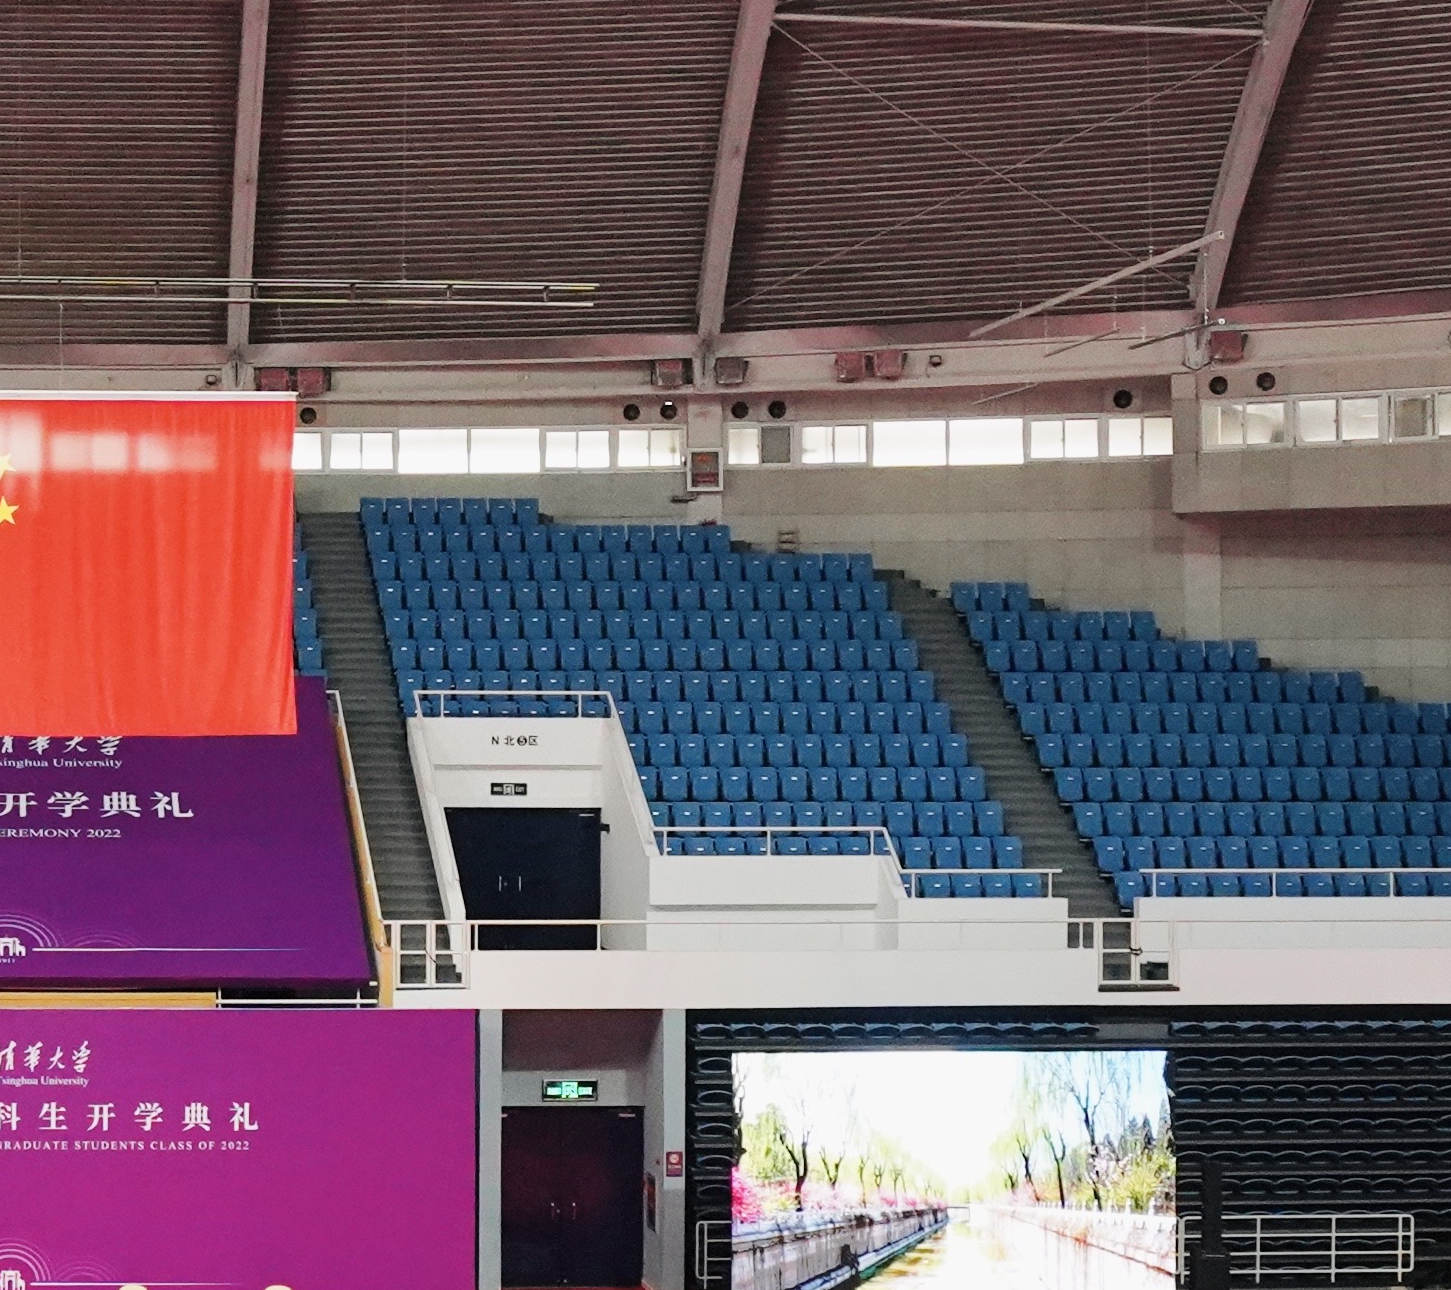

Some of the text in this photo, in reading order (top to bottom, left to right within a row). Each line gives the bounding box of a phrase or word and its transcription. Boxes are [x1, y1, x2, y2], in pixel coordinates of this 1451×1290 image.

[53, 757, 123, 769] University
[86, 828, 122, 838] 2022
[41, 1075, 90, 1088] University
[74, 1140, 145, 1151] STUDENTS
[149, 1140, 193, 1151] CLASS
[197, 1140, 216, 1151] OF
[220, 1140, 250, 1151] 2022
